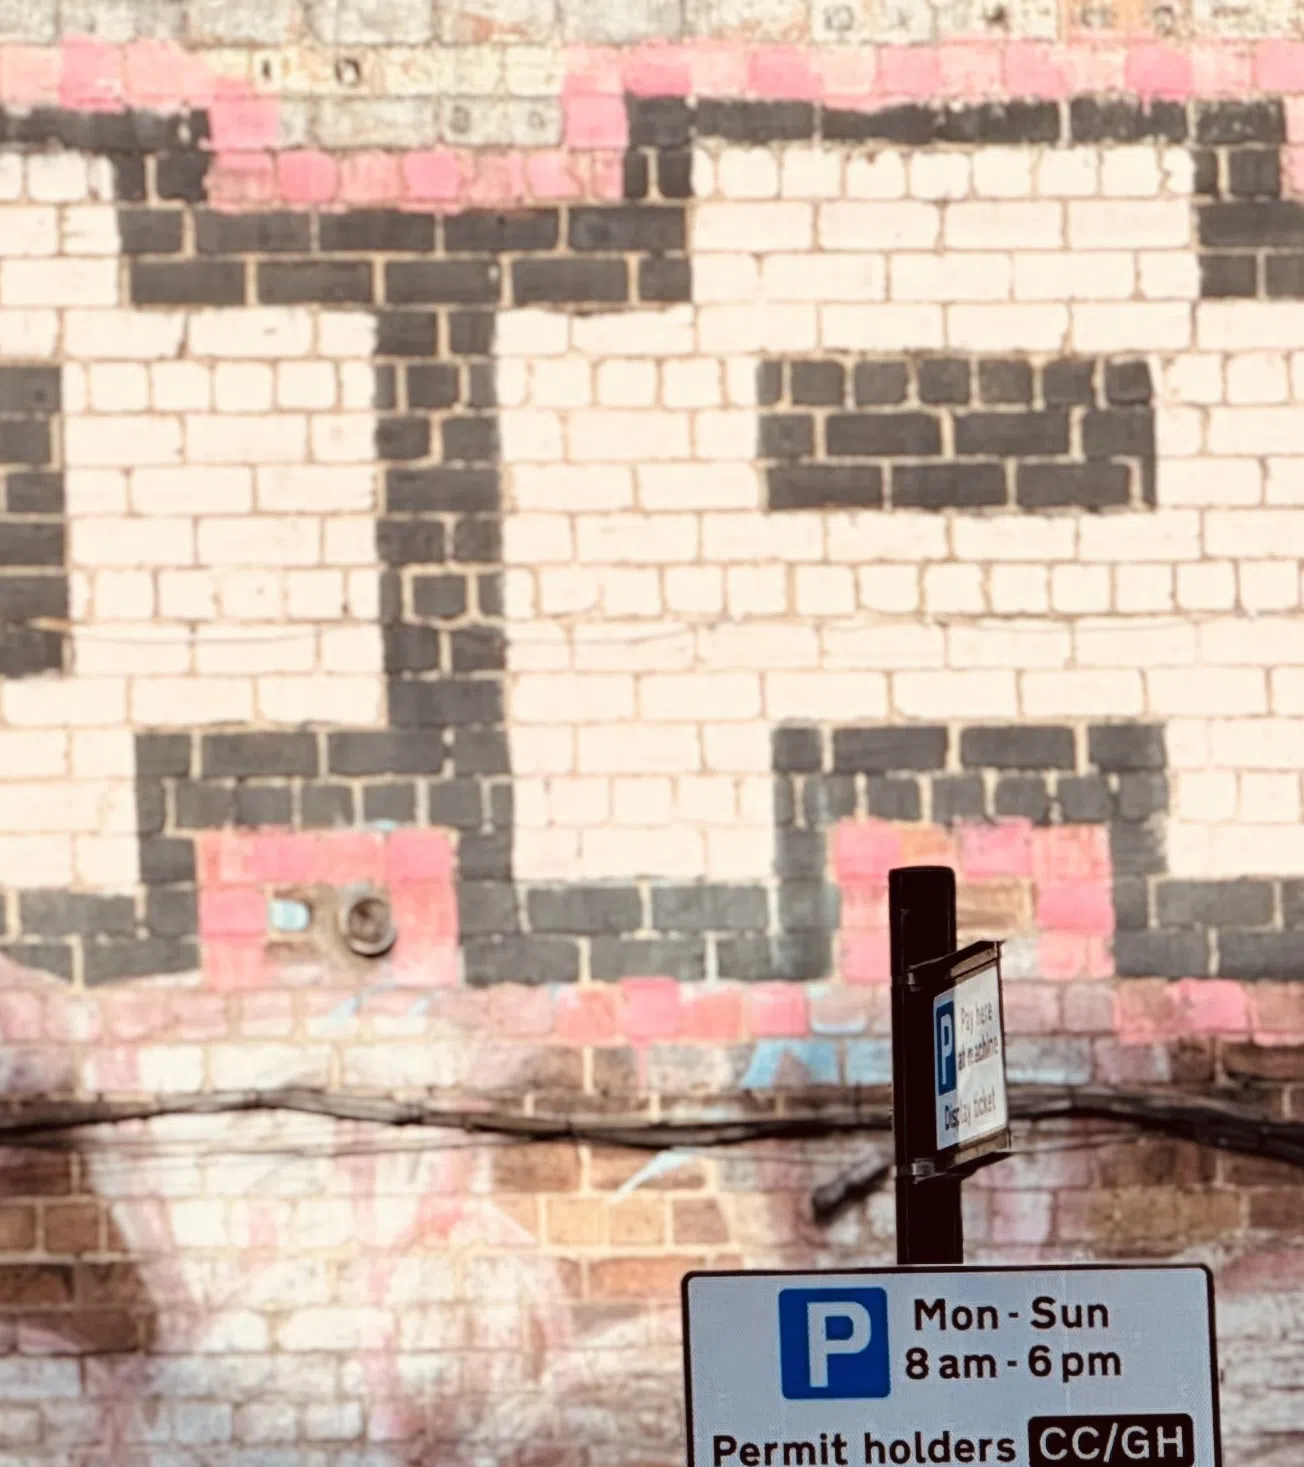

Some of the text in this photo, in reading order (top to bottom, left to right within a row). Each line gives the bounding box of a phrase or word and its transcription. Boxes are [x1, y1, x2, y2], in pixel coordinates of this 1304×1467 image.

[960, 1001, 993, 1036] Pay here
[958, 1035, 999, 1072] at machine
[944, 1084, 996, 1131] Display ticket
[806, 1301, 872, 1388] P
[714, 1422, 1184, 1467] Permit holders CC/GH
